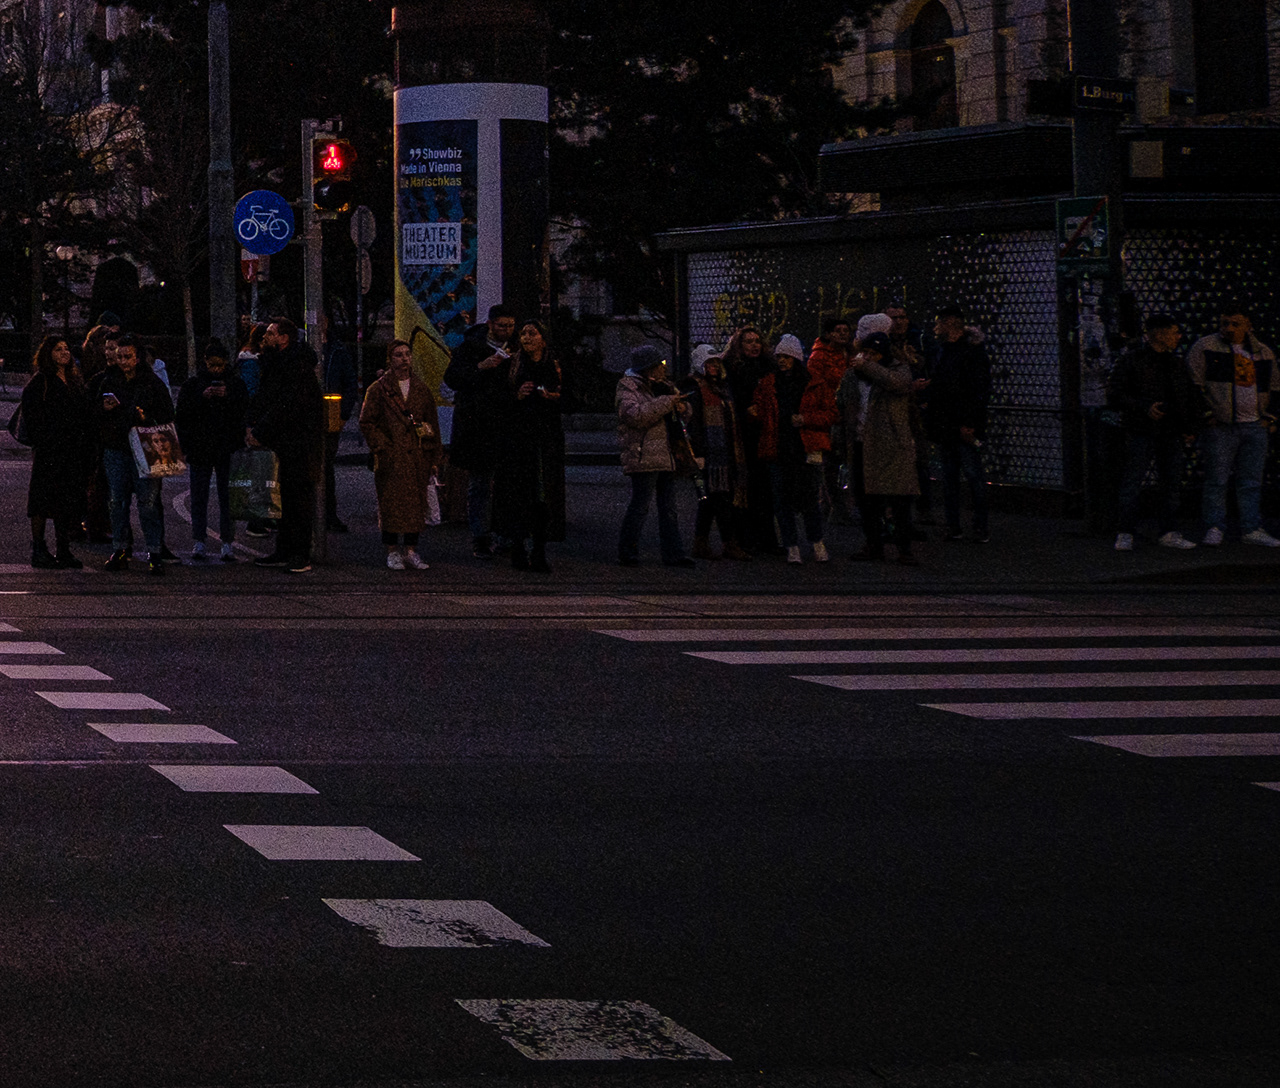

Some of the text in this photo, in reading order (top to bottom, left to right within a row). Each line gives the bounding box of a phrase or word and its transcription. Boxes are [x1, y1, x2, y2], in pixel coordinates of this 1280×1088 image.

[418, 162, 427, 174] in
[428, 162, 462, 173] Vienna
[410, 175, 462, 188] Marischkas
[404, 227, 457, 243] THEATER
